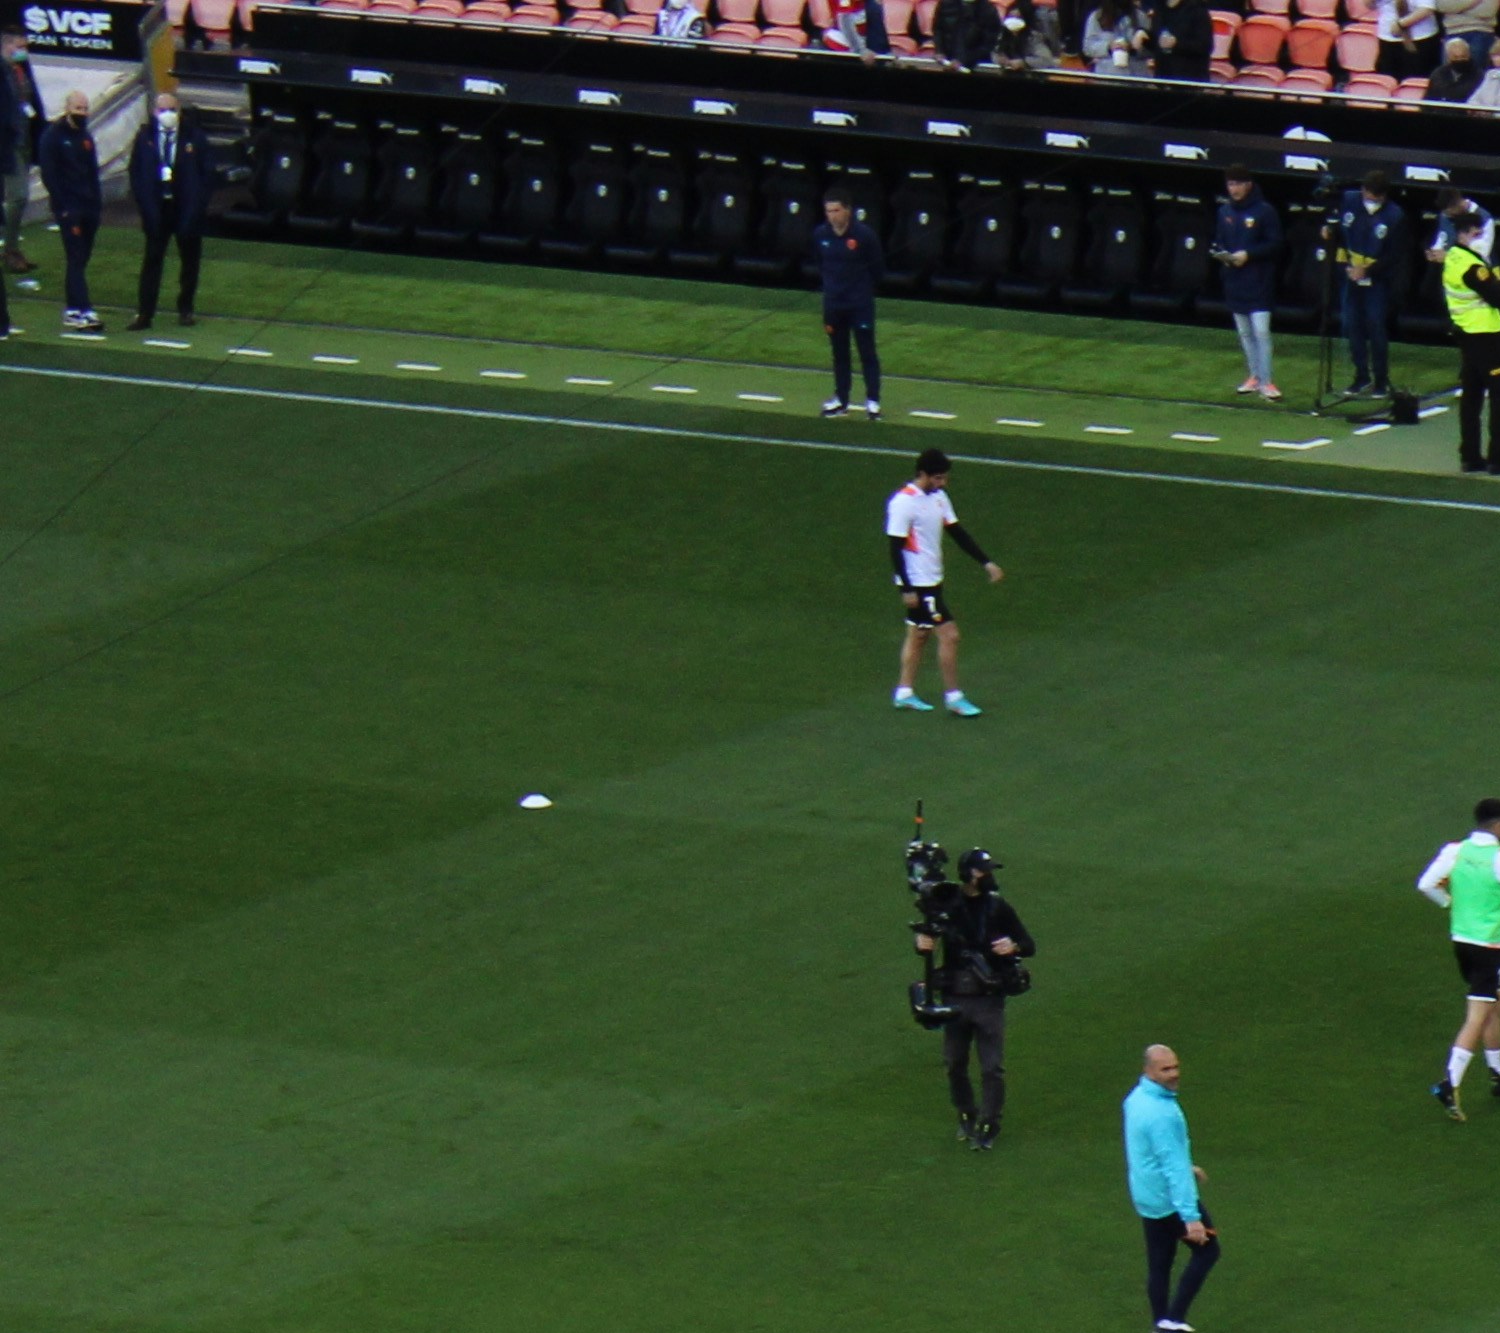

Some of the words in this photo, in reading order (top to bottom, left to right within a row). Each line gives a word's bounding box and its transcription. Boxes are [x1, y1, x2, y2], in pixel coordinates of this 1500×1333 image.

[22, 5, 114, 36] $VCF
[27, 34, 58, 46] FAN
[61, 36, 114, 50] TOKEN
